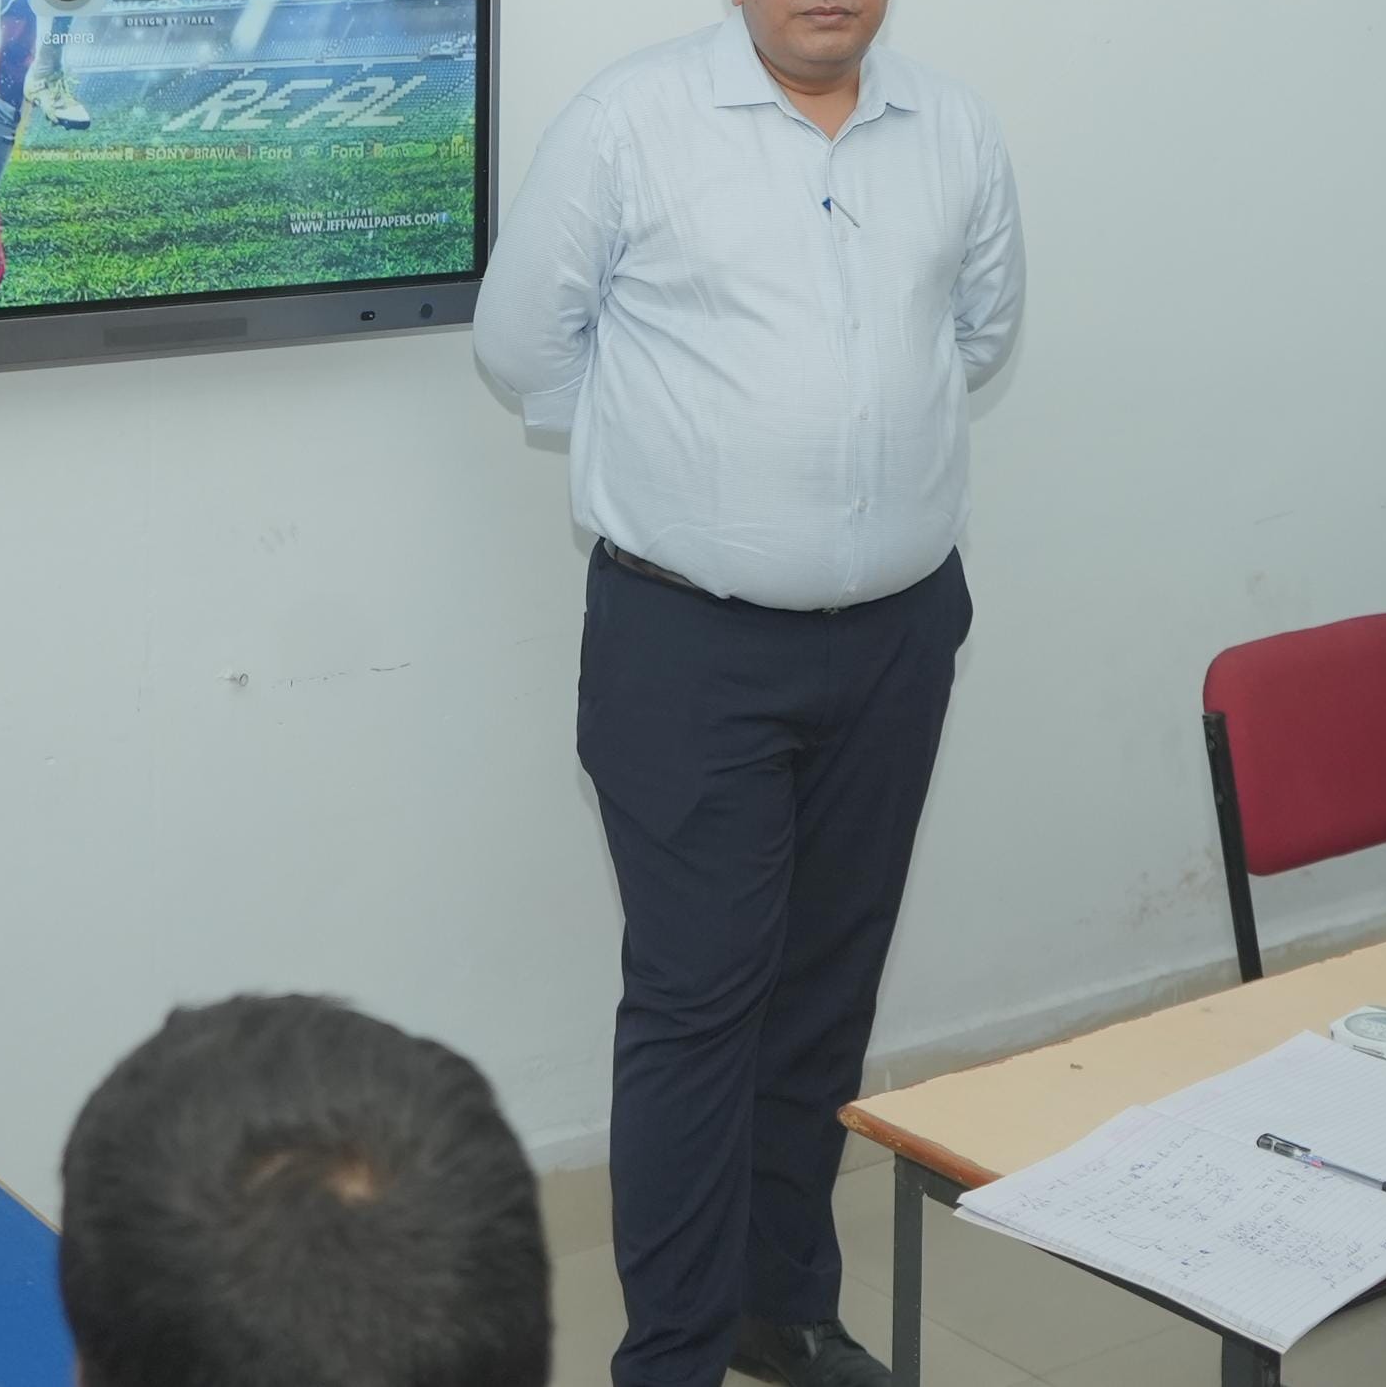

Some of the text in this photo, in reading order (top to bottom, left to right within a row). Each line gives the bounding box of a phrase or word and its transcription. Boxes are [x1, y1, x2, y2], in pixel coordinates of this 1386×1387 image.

[43, 31, 94, 45] Camera
[146, 148, 236, 161] SONY BRAVIA
[259, 145, 292, 159] Ford
[331, 141, 364, 159] Ford
[290, 213, 439, 234] WWW.JEFFWALLPAPERS.COM
